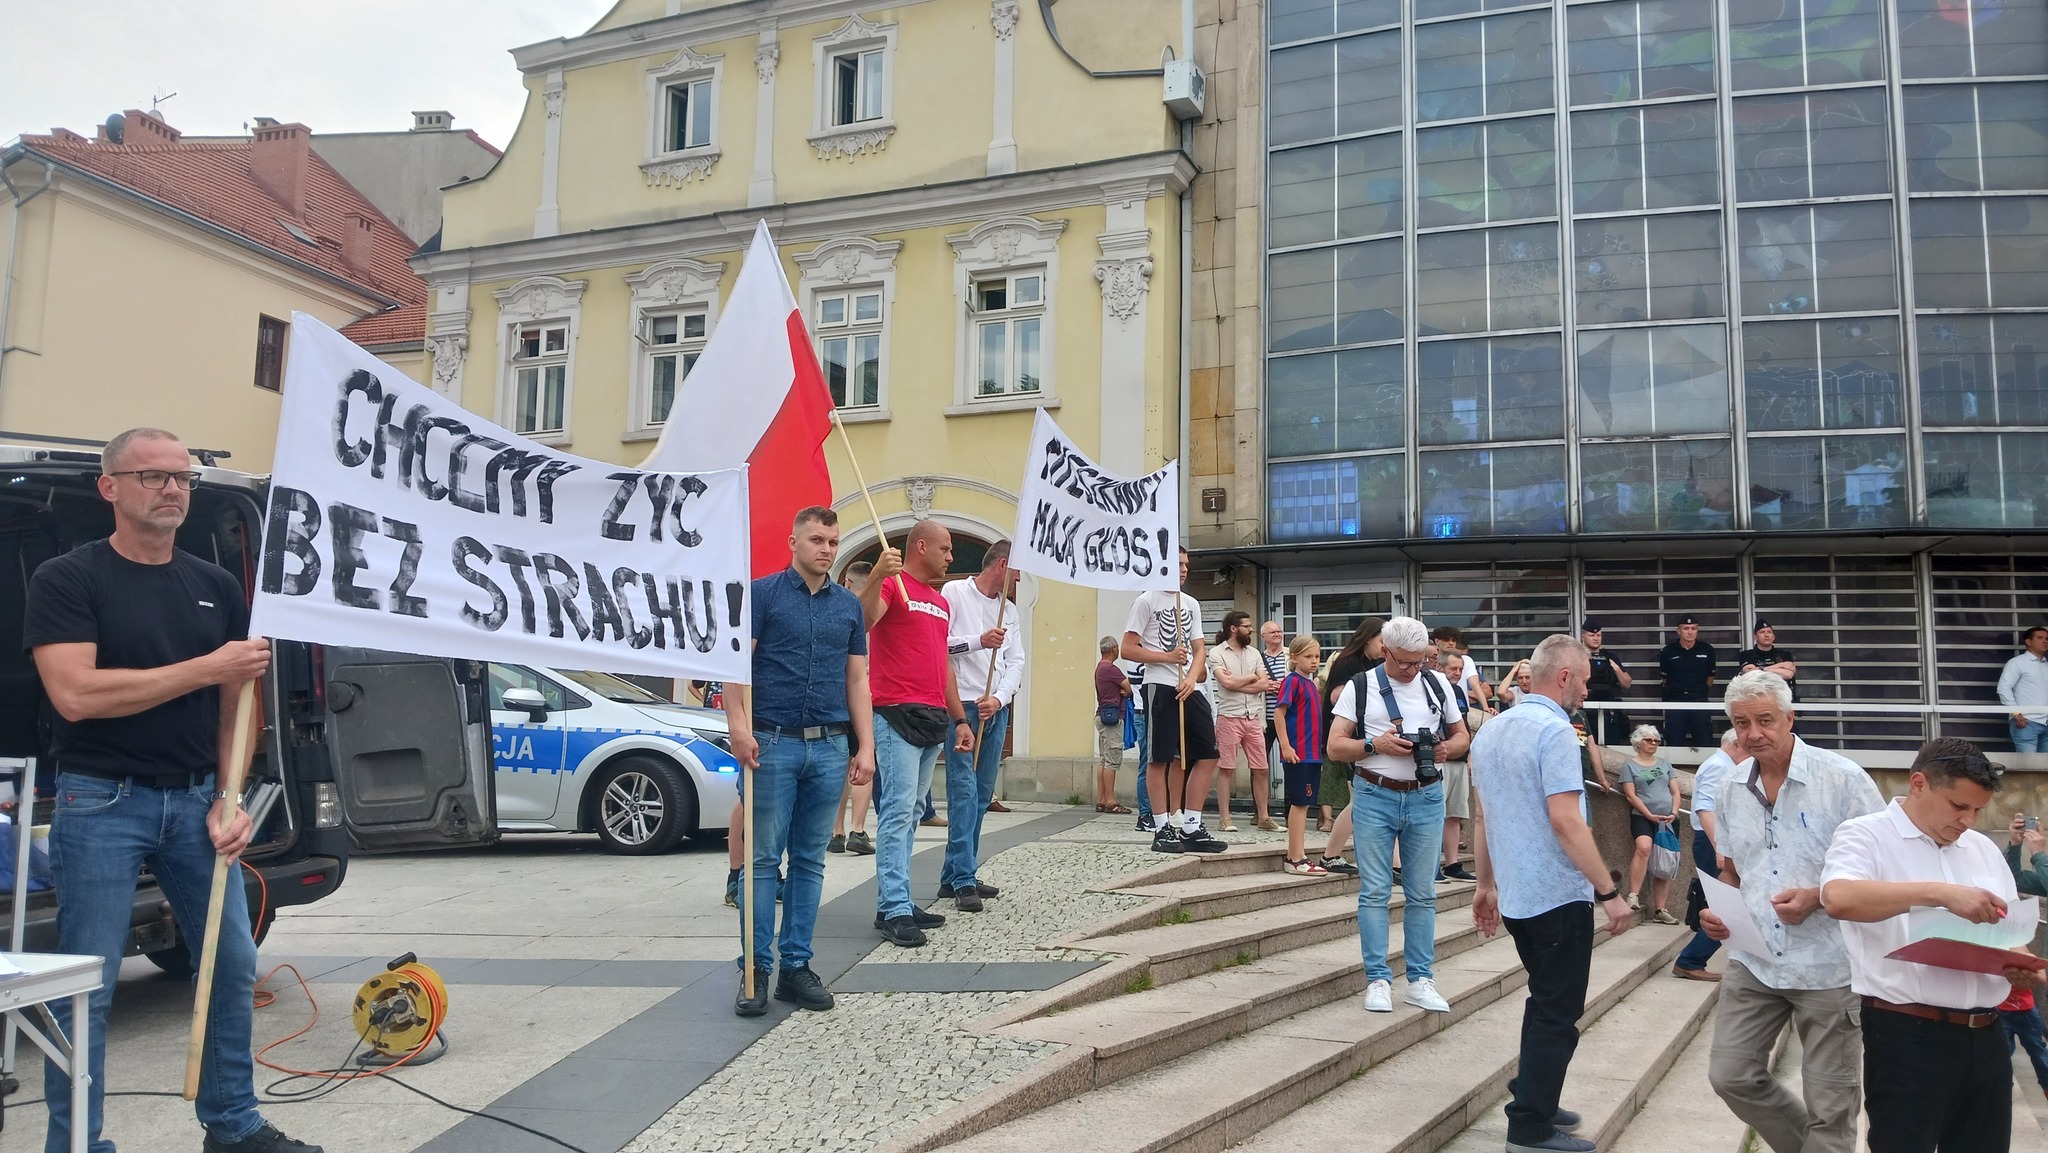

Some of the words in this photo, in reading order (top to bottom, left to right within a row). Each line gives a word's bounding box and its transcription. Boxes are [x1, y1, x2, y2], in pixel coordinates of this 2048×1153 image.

[1209, 497, 1217, 509] 1
[261, 485, 428, 618] BEZ
[452, 536, 744, 653] STRACHU!
